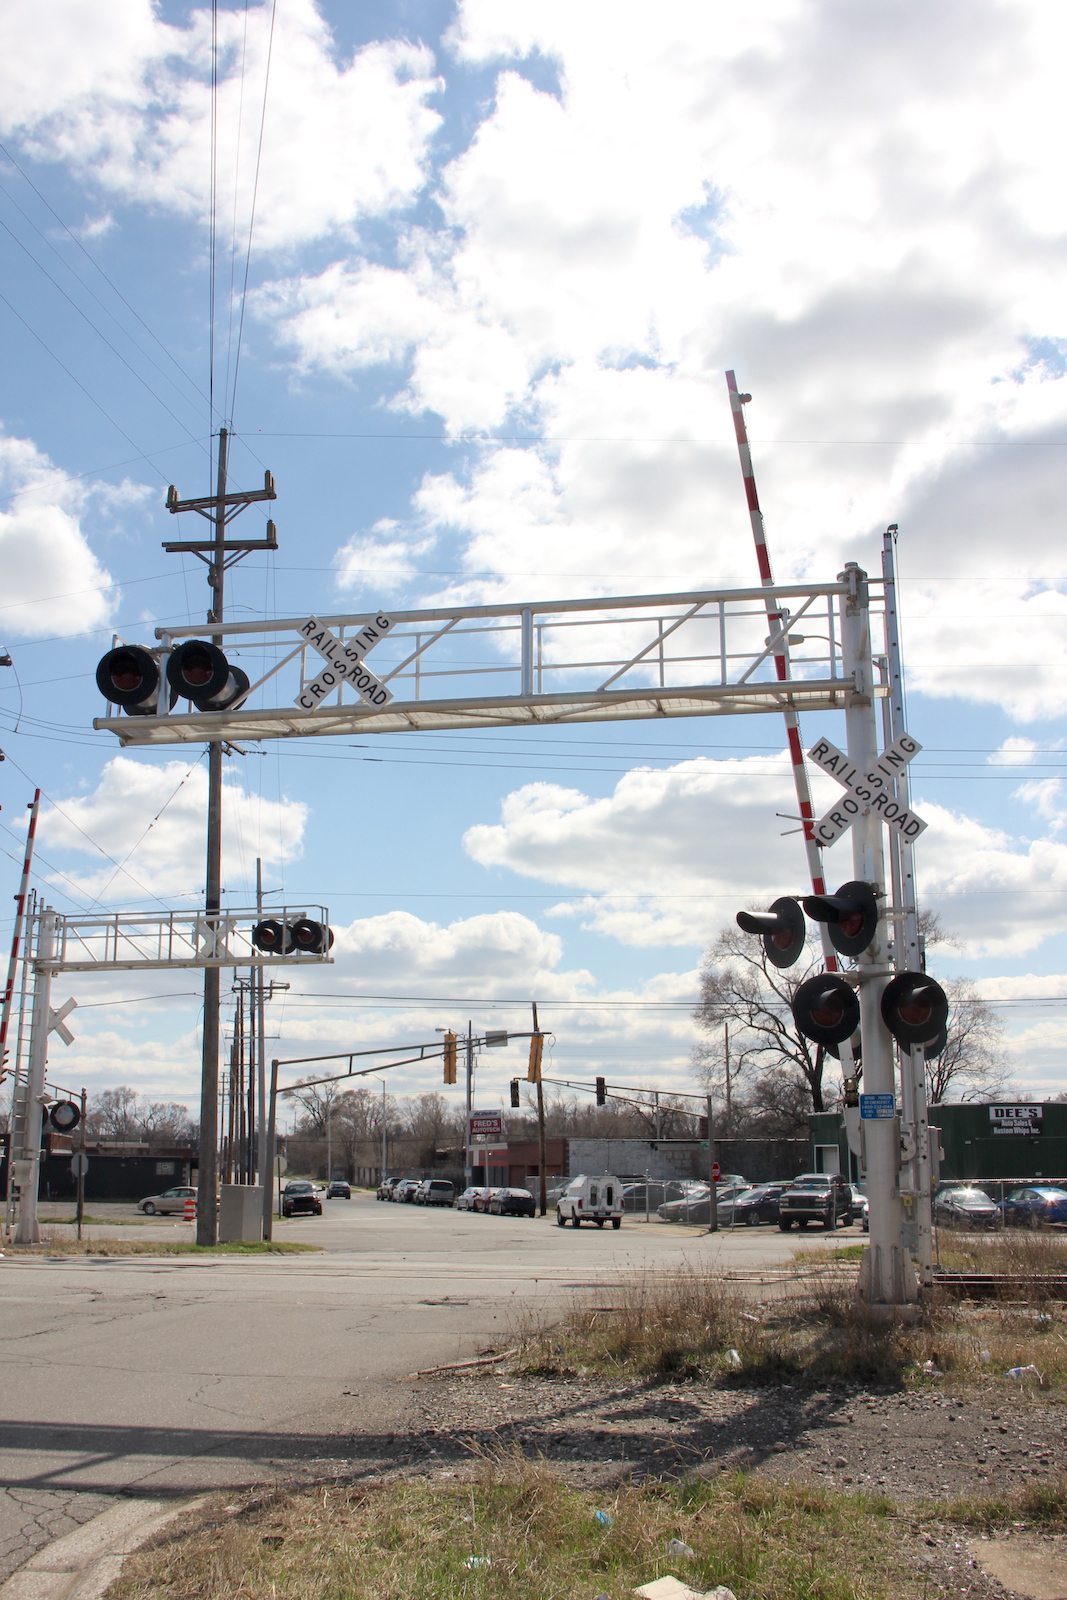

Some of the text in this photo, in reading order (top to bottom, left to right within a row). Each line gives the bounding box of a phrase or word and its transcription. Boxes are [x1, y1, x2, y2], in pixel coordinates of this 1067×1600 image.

[300, 616, 389, 709] CROSSING
[818, 738, 916, 840] CROSSING
[994, 1108, 1038, 1118] DEE'S
[473, 1119, 498, 1128] FRED'S
[1001, 1119, 1013, 1127] Auto
[1013, 1119, 1028, 1127] Sales
[471, 1126, 501, 1134] AUTOTECH
[993, 1126, 1013, 1135] Kustom
[1013, 1126, 1030, 1136] Whips
